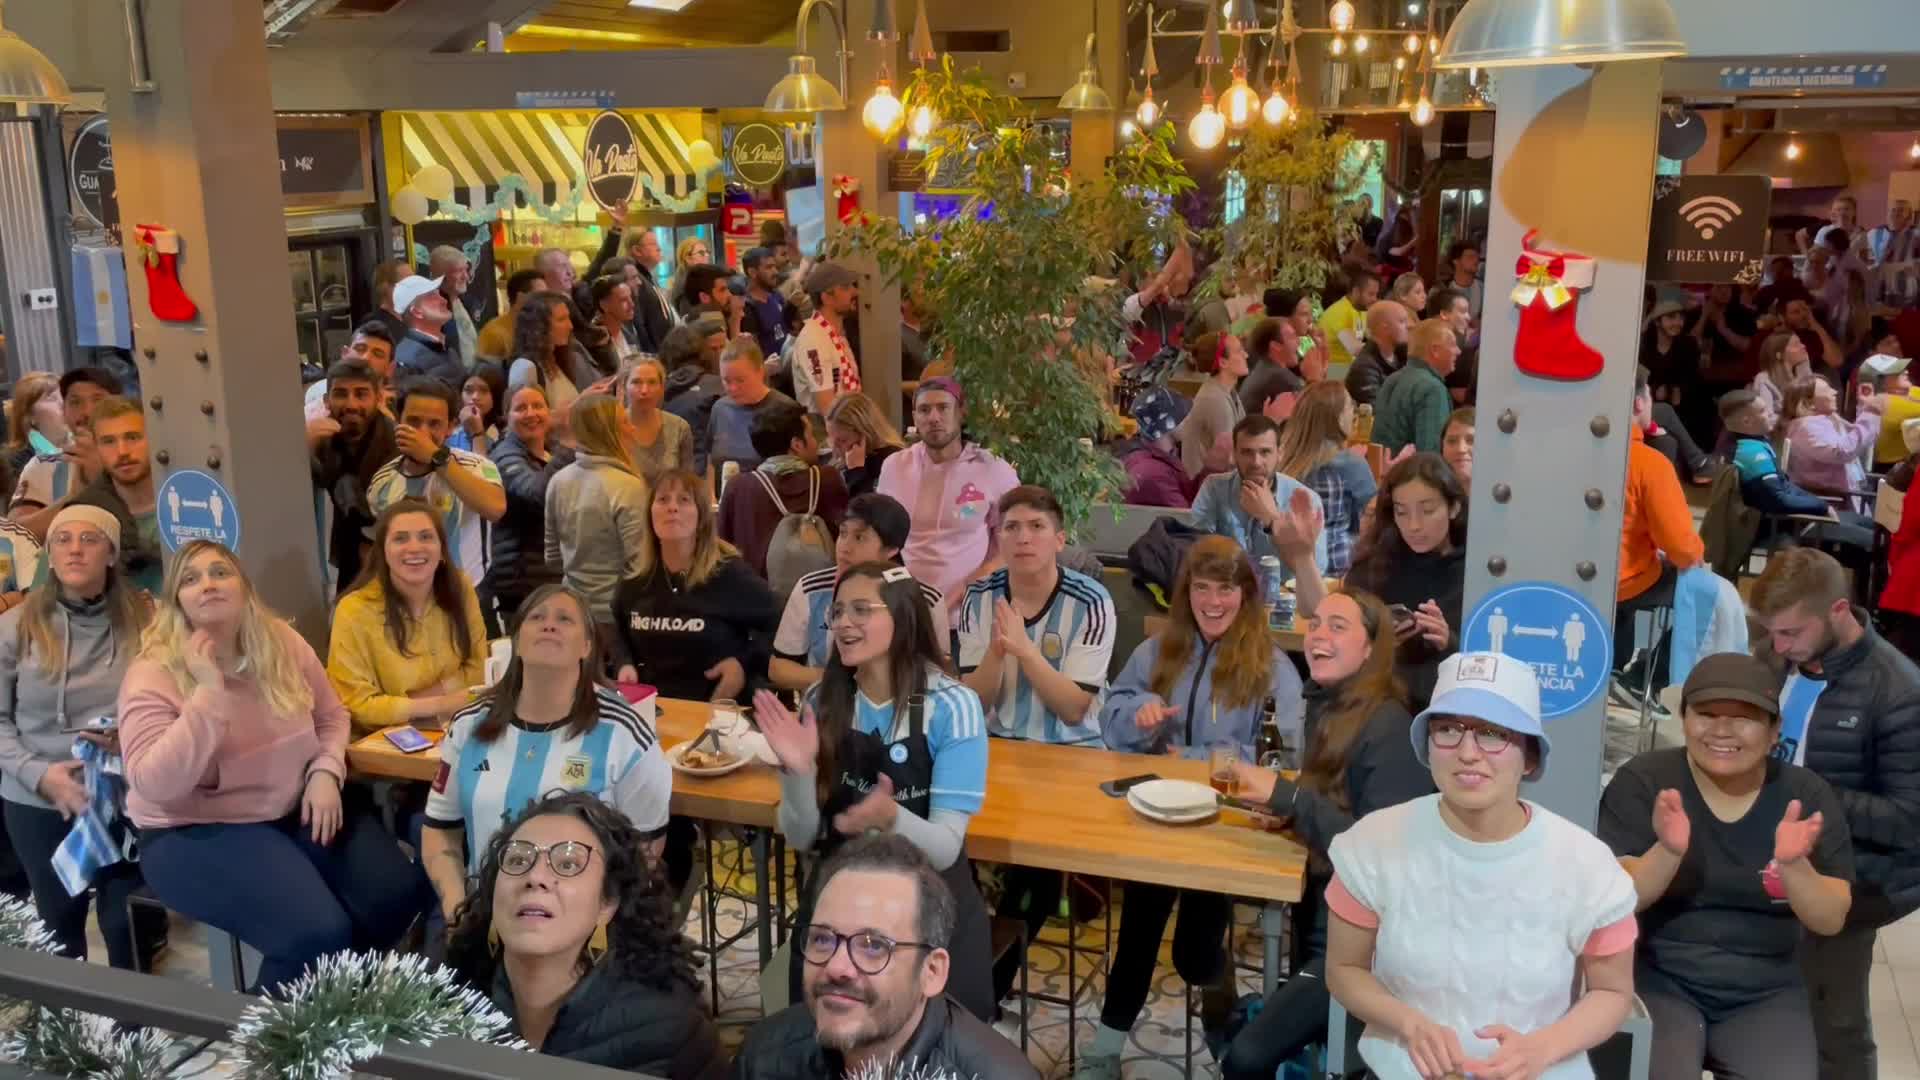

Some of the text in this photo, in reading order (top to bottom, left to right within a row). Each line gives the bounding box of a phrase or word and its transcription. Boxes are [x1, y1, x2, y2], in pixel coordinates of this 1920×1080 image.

[1666, 249, 1745, 263] FREE WIFI
[1563, 664, 1584, 679] LA
